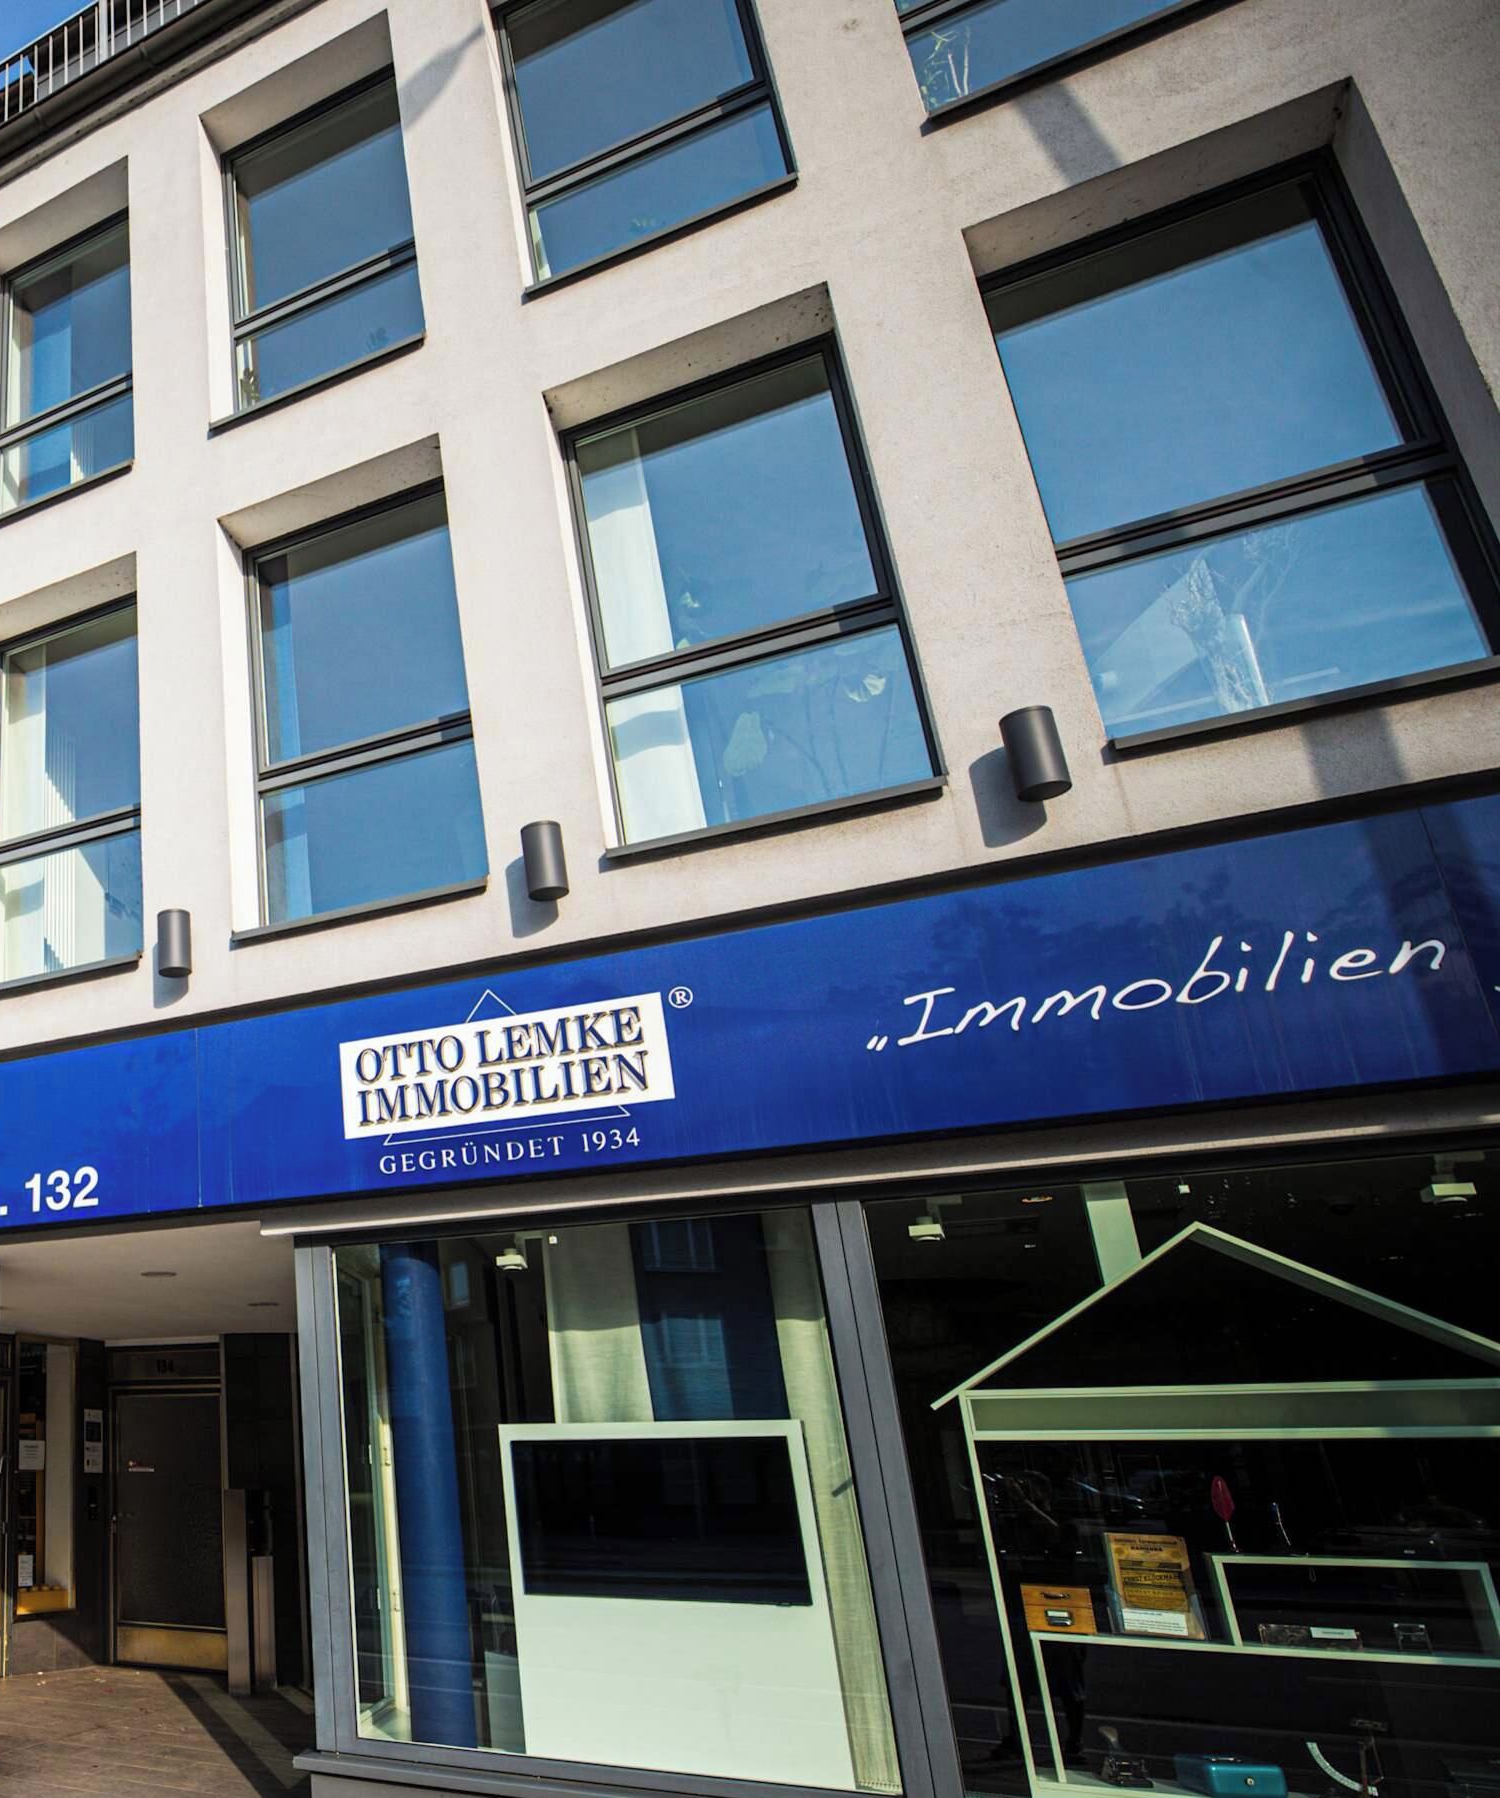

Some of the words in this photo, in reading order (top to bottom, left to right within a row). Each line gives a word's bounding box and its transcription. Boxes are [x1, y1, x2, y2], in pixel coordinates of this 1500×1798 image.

[355, 1034, 466, 1085] OTTO
[474, 1005, 646, 1068] LEMKE
[357, 1049, 651, 1128] IMMOBILIEN
[378, 1135, 565, 1176] GEGRÜNDET
[582, 1127, 641, 1154] 1934
[24, 1165, 100, 1213] 132
